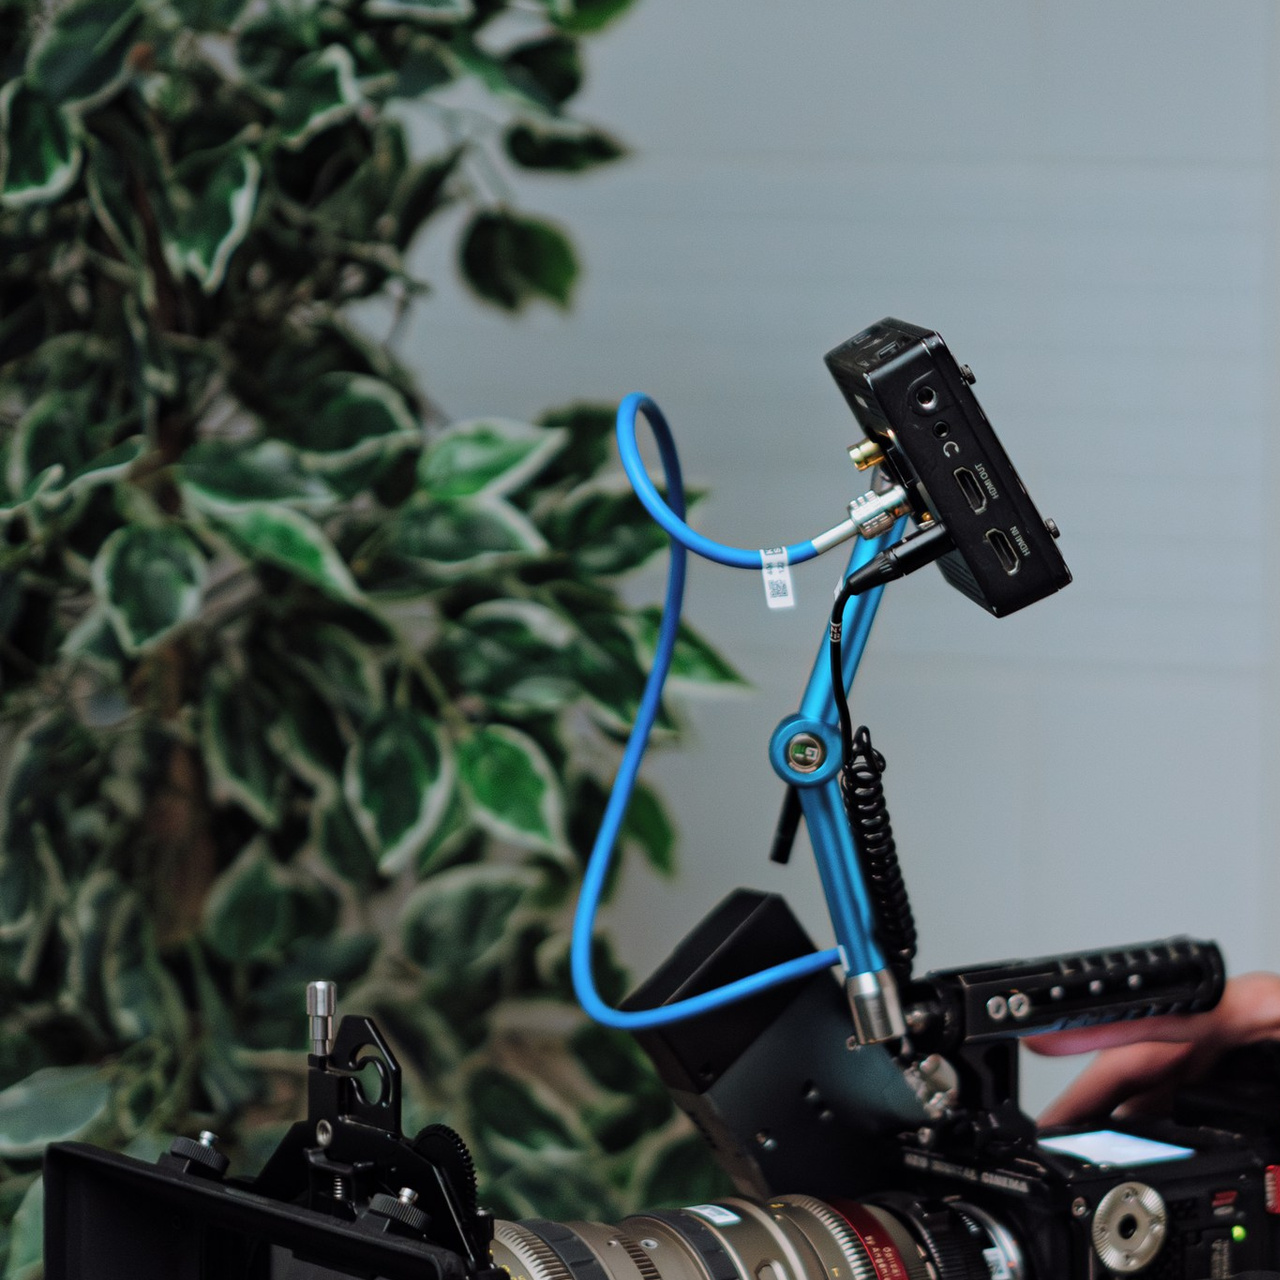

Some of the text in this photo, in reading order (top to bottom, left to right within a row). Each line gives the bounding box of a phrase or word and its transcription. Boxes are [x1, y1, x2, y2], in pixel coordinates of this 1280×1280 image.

[974, 463, 999, 500] HDMI OUT
[1009, 525, 1031, 557] HDMI IN
